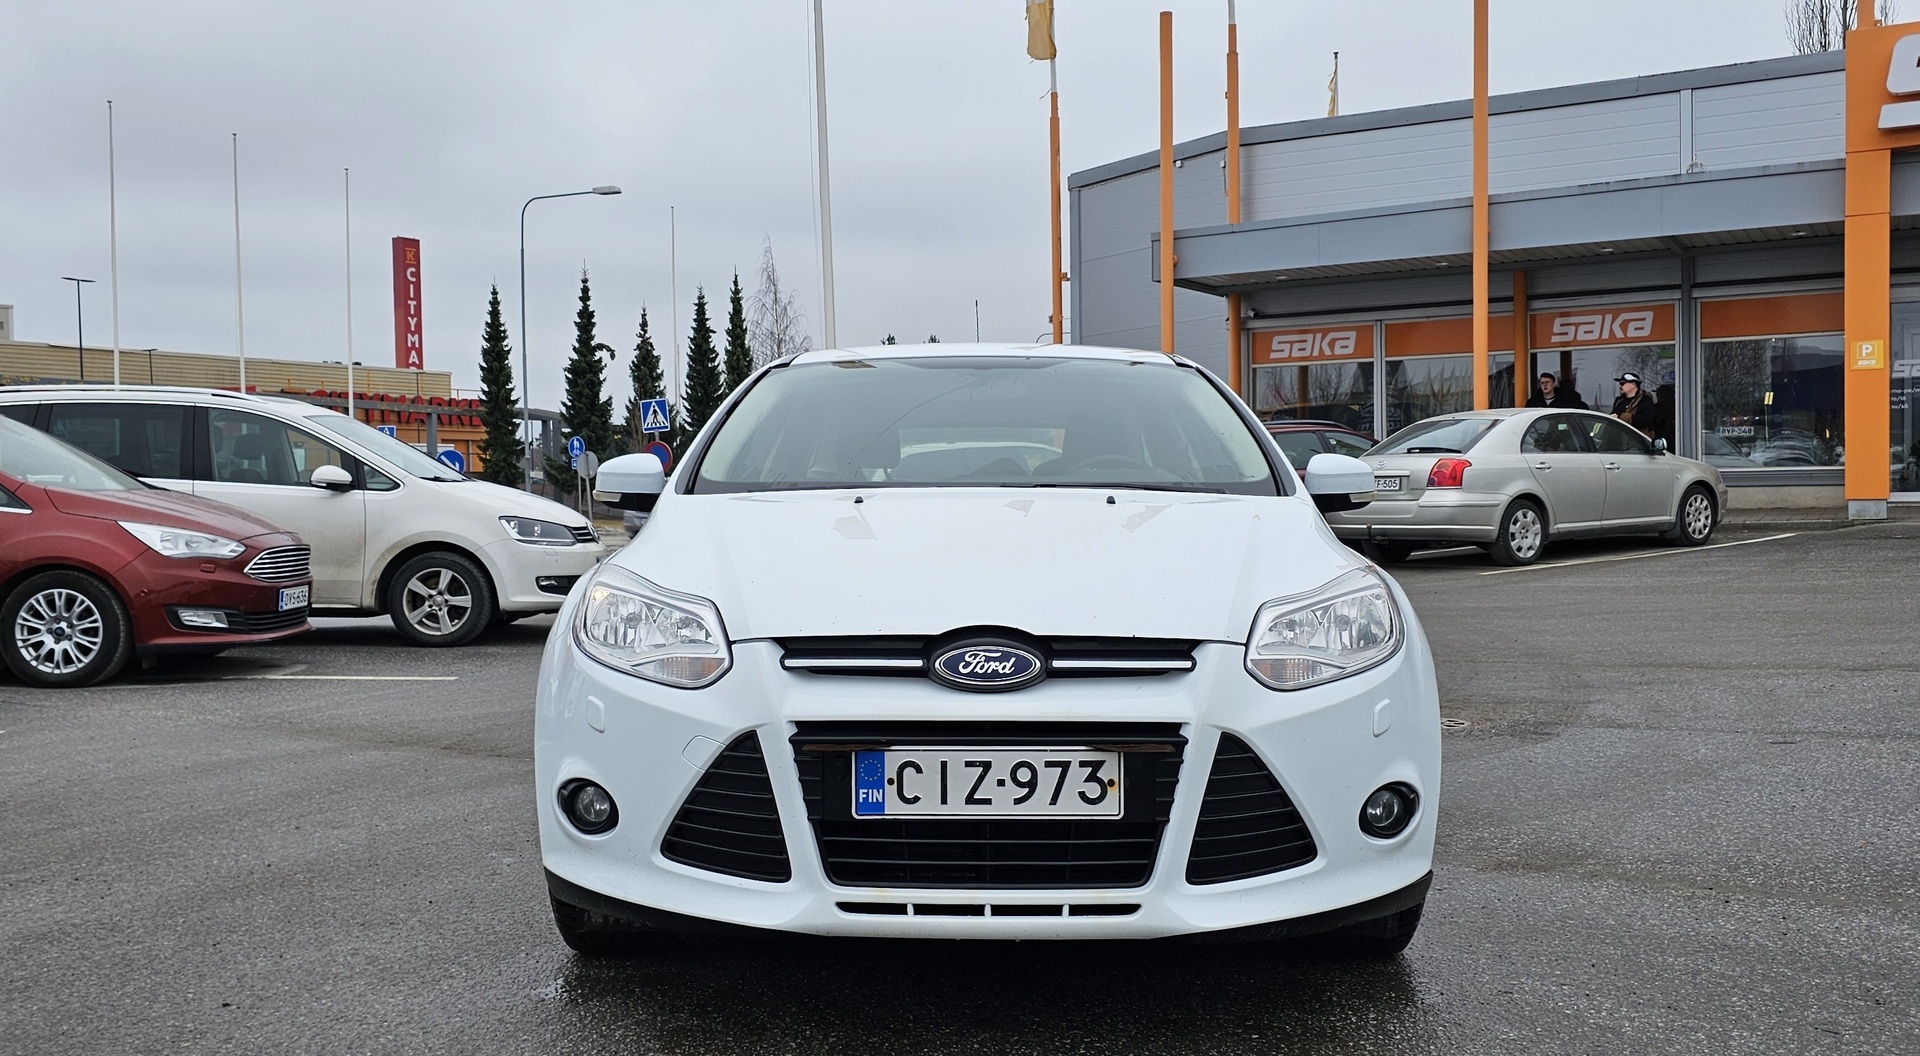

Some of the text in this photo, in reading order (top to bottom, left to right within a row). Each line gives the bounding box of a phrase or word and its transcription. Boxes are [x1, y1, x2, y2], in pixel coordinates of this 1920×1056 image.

[406, 267, 420, 371] CITYMA
[1861, 344, 1873, 358] P
[1374, 479, 1398, 489] F-505
[957, 650, 1016, 675] Ford
[895, 759, 1109, 806] CIZ-973
[858, 787, 883, 804] FIN
